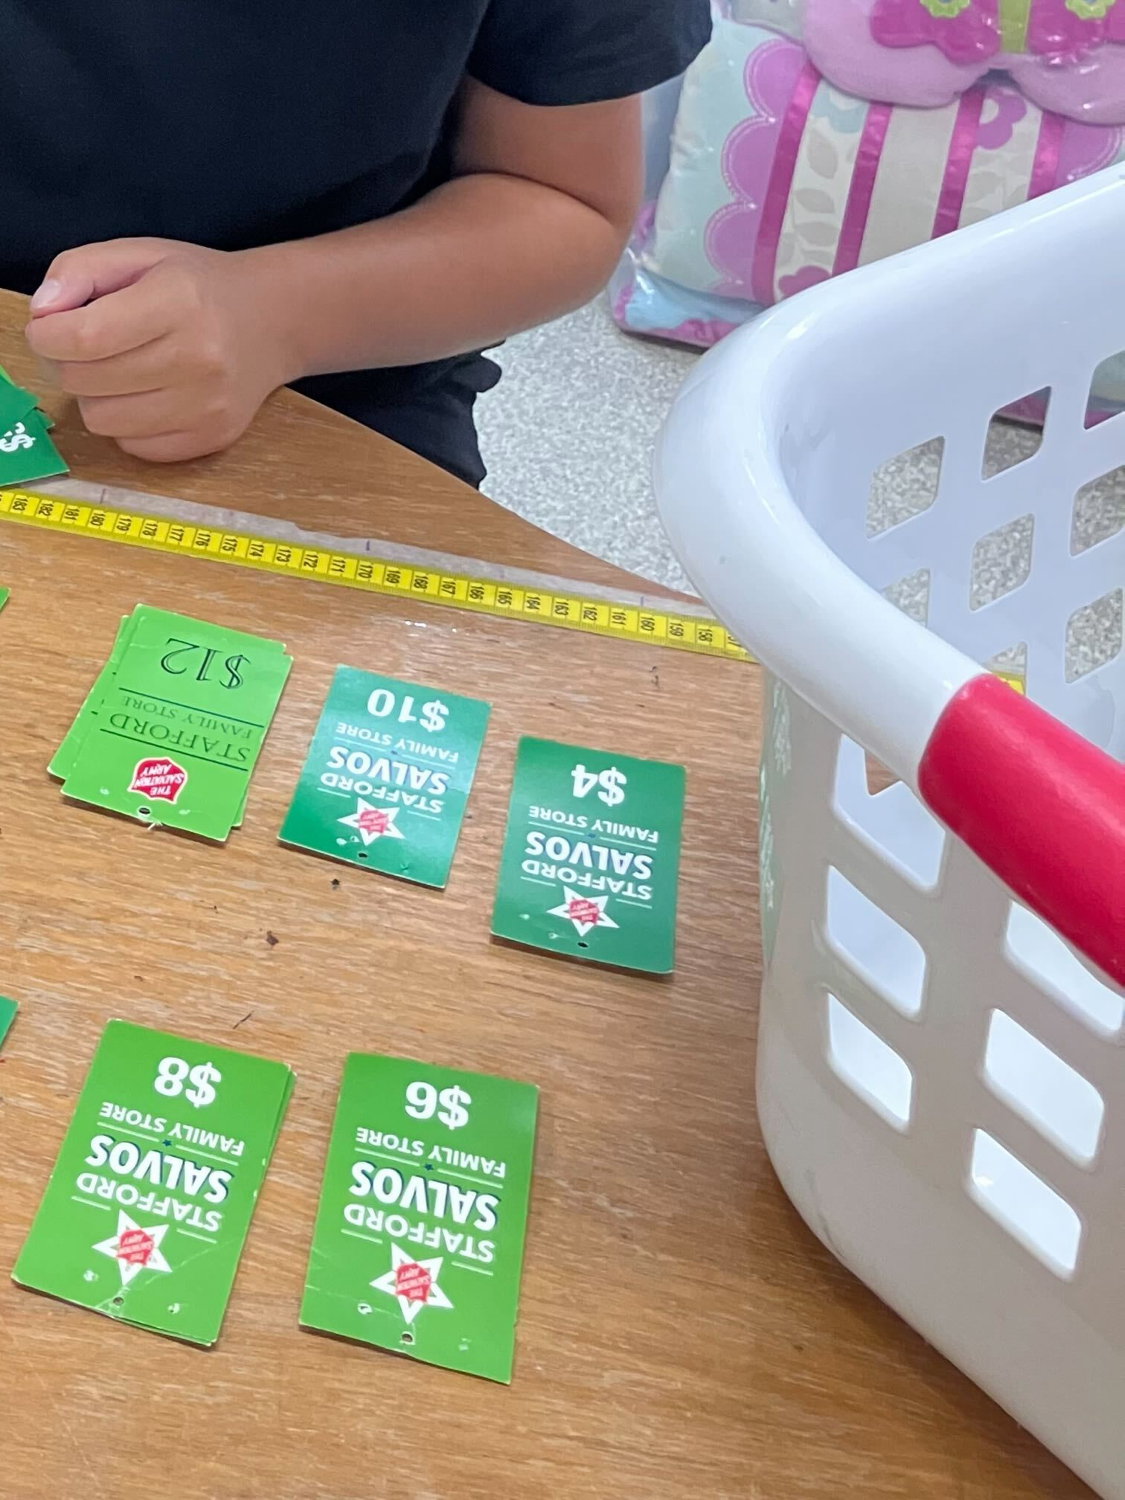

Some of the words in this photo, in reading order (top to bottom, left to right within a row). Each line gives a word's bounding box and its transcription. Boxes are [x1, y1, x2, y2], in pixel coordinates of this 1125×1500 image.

[12, 497, 27, 511] 183
[39, 502, 54, 516] 182
[65, 507, 80, 521] 181
[90, 512, 105, 527] 180
[117, 517, 132, 532] 179
[143, 522, 158, 537] 178
[169, 526, 185, 542] 177
[196, 532, 211, 547] 176
[222, 537, 238, 552] 175
[249, 542, 264, 557] 174
[276, 548, 291, 563] 173
[303, 553, 319, 569] 172
[331, 558, 346, 573] 171
[358, 564, 373, 579] 170
[386, 569, 401, 584] 169
[414, 575, 428, 590] 168
[441, 580, 456, 595] 167
[470, 585, 484, 600] 166
[498, 590, 512, 605] 165
[527, 595, 541, 610] 164
[554, 601, 569, 616] 163
[583, 607, 597, 621] 162
[612, 612, 626, 626] 161
[640, 616, 655, 632] 160
[669, 622, 684, 637] 159
[698, 628, 713, 643] 158
[160, 637, 252, 690] $12
[123, 696, 179, 720] STORE
[182, 713, 253, 739] FAMILY
[367, 688, 450, 733] $10
[109, 712, 251, 763] STAFFORD
[335, 722, 393, 745] STORE
[394, 738, 459, 763] FAMILY
[133, 773, 185, 788] SALVATION
[140, 763, 173, 777] ARMY
[149, 785, 172, 796] THE
[326, 746, 450, 796] SALVOS
[570, 763, 628, 807] $4
[320, 772, 446, 814] STAFFORD
[528, 805, 588, 828] STORE
[591, 819, 659, 844] FAMILY
[524, 831, 654, 880] SALVOS
[521, 859, 653, 901] STAFFORD
[153, 1056, 222, 1109] $8
[99, 1102, 168, 1133] STORE
[404, 1080, 472, 1131] $6
[168, 1122, 245, 1157] FAMILY
[355, 1126, 425, 1157] STORE
[84, 1134, 235, 1204] SALVOS
[428, 1145, 507, 1179] FAMILY
[76, 1172, 224, 1233] STAFFORD
[348, 1160, 502, 1232] SALVOS
[343, 1203, 496, 1264] STAFFORD
